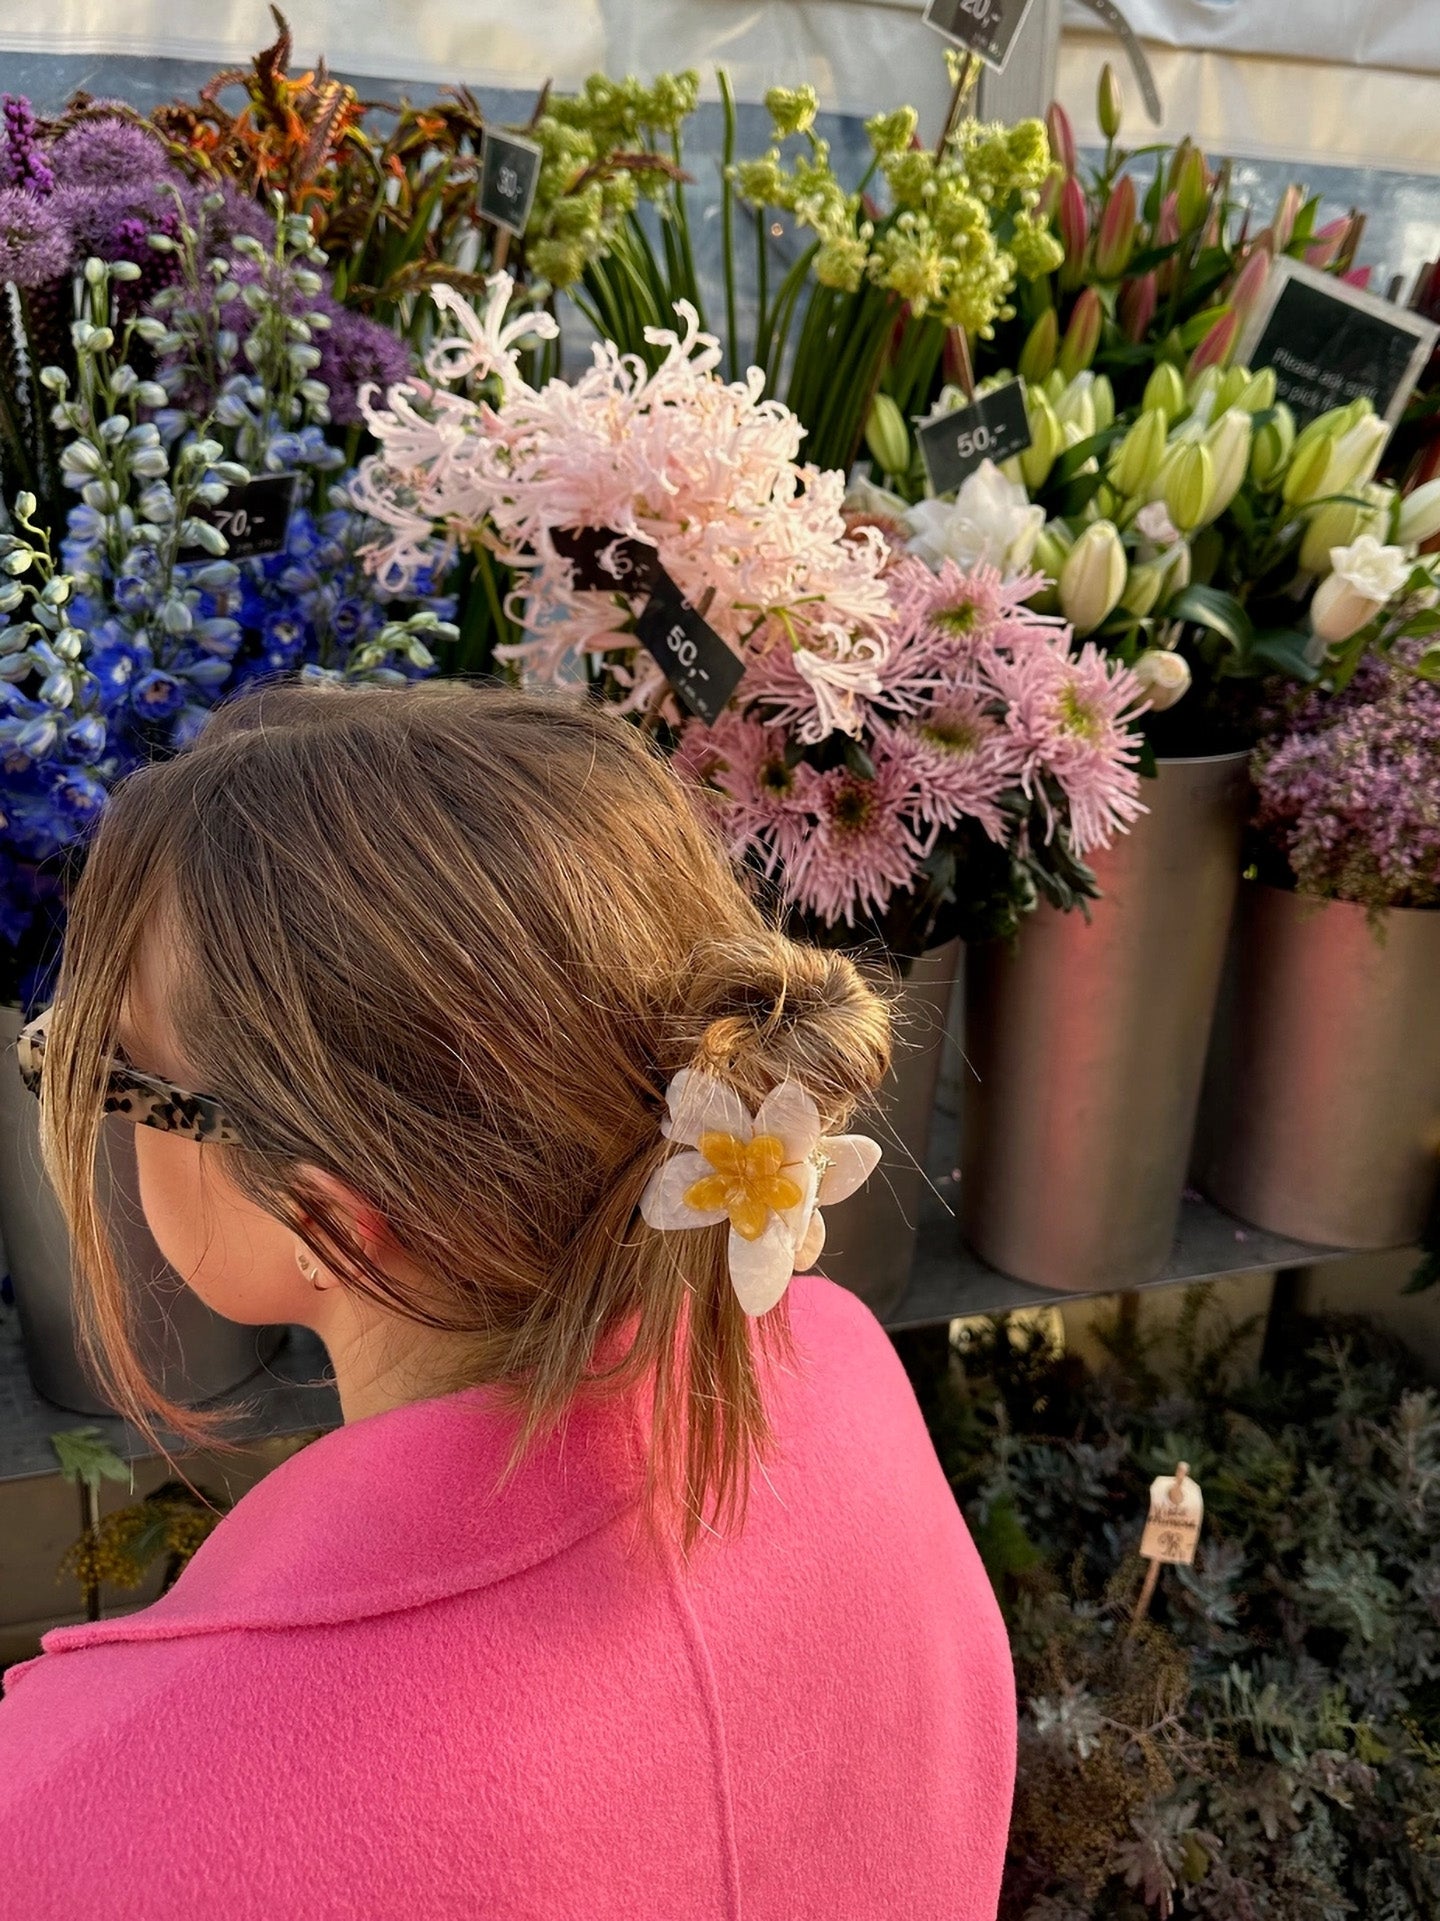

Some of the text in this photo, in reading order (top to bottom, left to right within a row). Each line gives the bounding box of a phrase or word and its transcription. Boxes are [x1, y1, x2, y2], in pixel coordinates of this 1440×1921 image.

[957, 424, 1006, 458] 50,-
[213, 509, 265, 537] 70,-
[666, 625, 709, 682] 50,-
